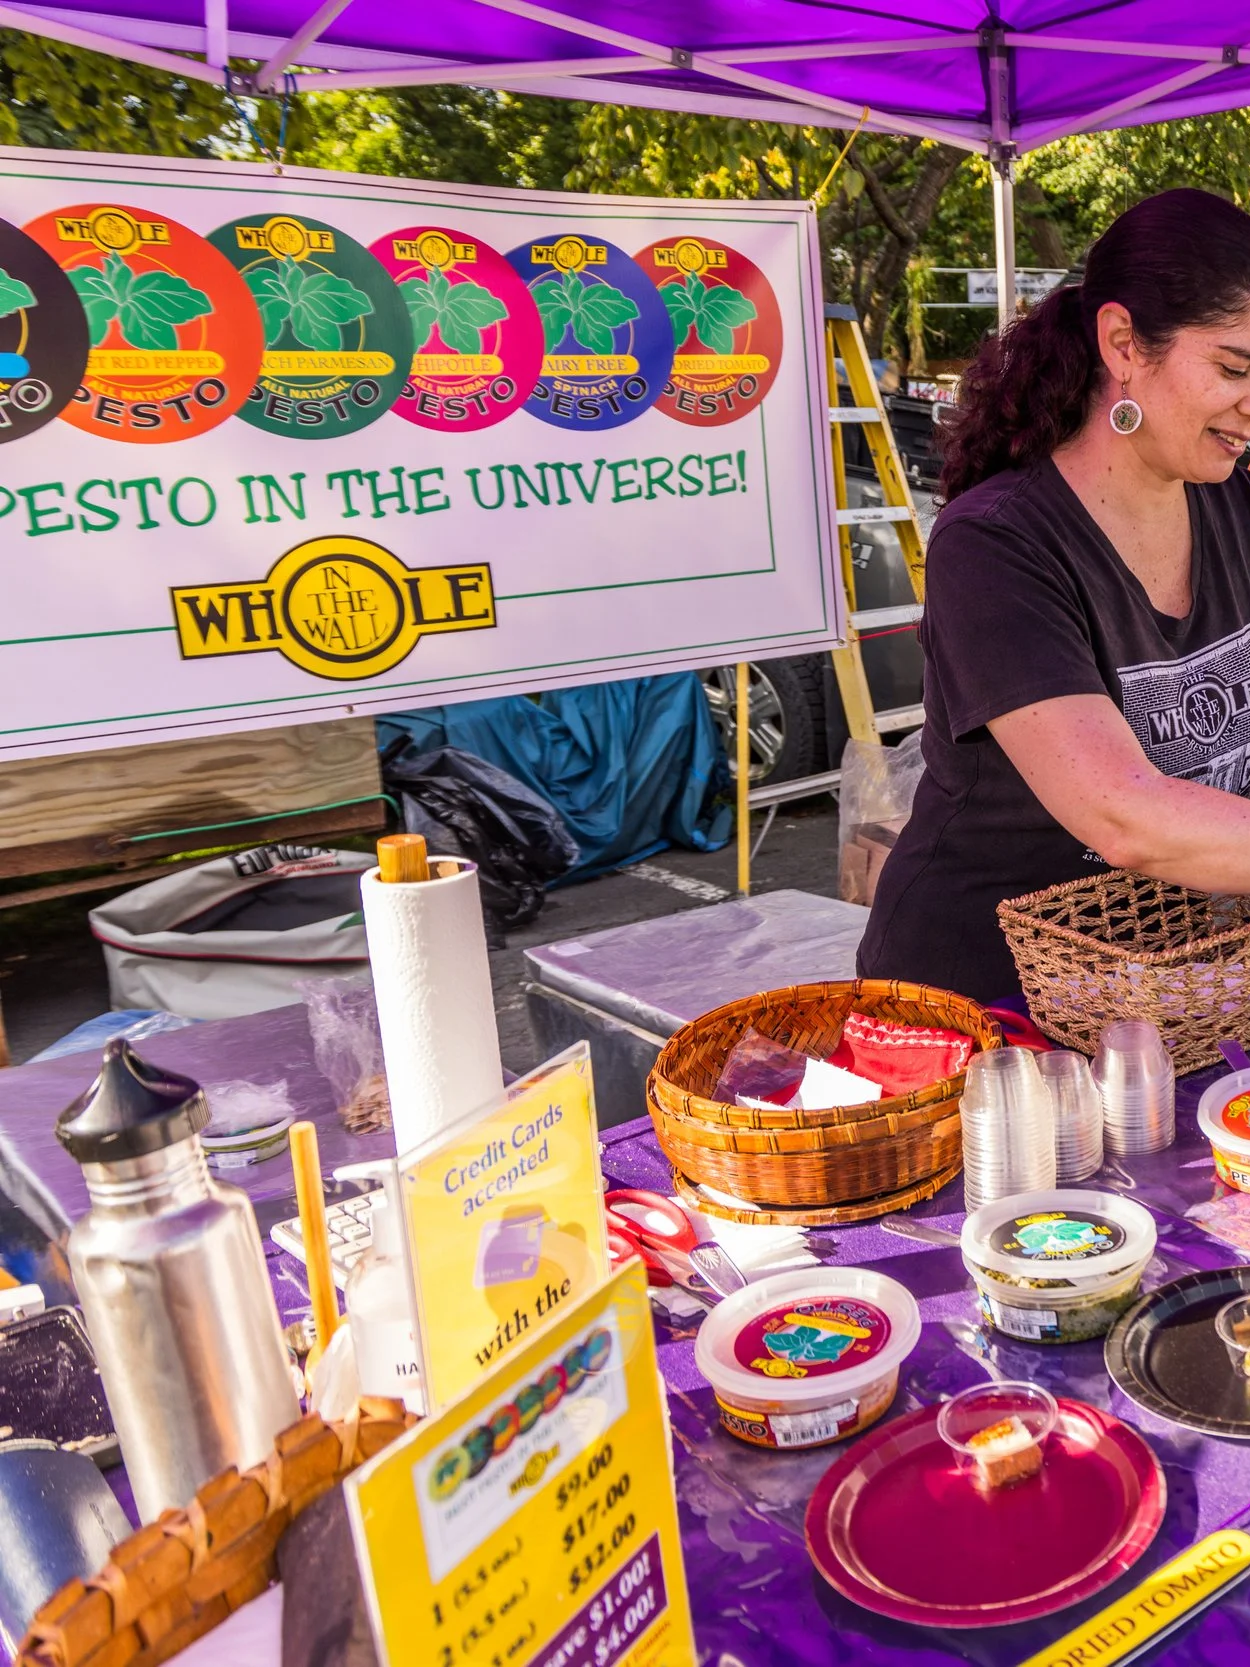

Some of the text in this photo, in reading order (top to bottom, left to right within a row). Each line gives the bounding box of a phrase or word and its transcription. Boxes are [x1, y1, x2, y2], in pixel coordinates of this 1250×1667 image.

[113, 356, 219, 370] RED PEPPER
[297, 357, 391, 370] PARMESAN
[587, 359, 628, 371] FREE
[718, 360, 767, 370] TOMATO
[89, 380, 192, 402] ALL NATURAL
[260, 378, 352, 400] ALL NATURAL
[412, 377, 490, 396] ALL NATURAL
[552, 380, 617, 396] SPINACH
[672, 375, 737, 394] ALL NATURAL
[238, 472, 306, 524] IN
[327, 466, 451, 518] THE
[469, 449, 749, 511] UNIVERSE!
[319, 566, 351, 590] IN
[182, 554, 490, 664] WHOLE
[307, 589, 380, 617] THE
[303, 613, 392, 651] WALL
[1183, 673, 1205, 687] THE
[1191, 690, 1209, 706] IN
[1189, 700, 1220, 721] THE
[1192, 712, 1224, 736] WALL
[1187, 721, 1236, 755] RESTAURANT
[1082, 853, 1093, 861] 43
[444, 1103, 563, 1194] Credit Cards
[463, 1138, 550, 1217] accepted
[475, 1277, 571, 1367] with the
[556, 1443, 614, 1512] $9.00
[562, 1472, 631, 1554] $17.00
[590, 1551, 651, 1632] $1.00!
[1133, 1540, 1244, 1621] TOMATO
[594, 1585, 656, 1667] $4.00!
